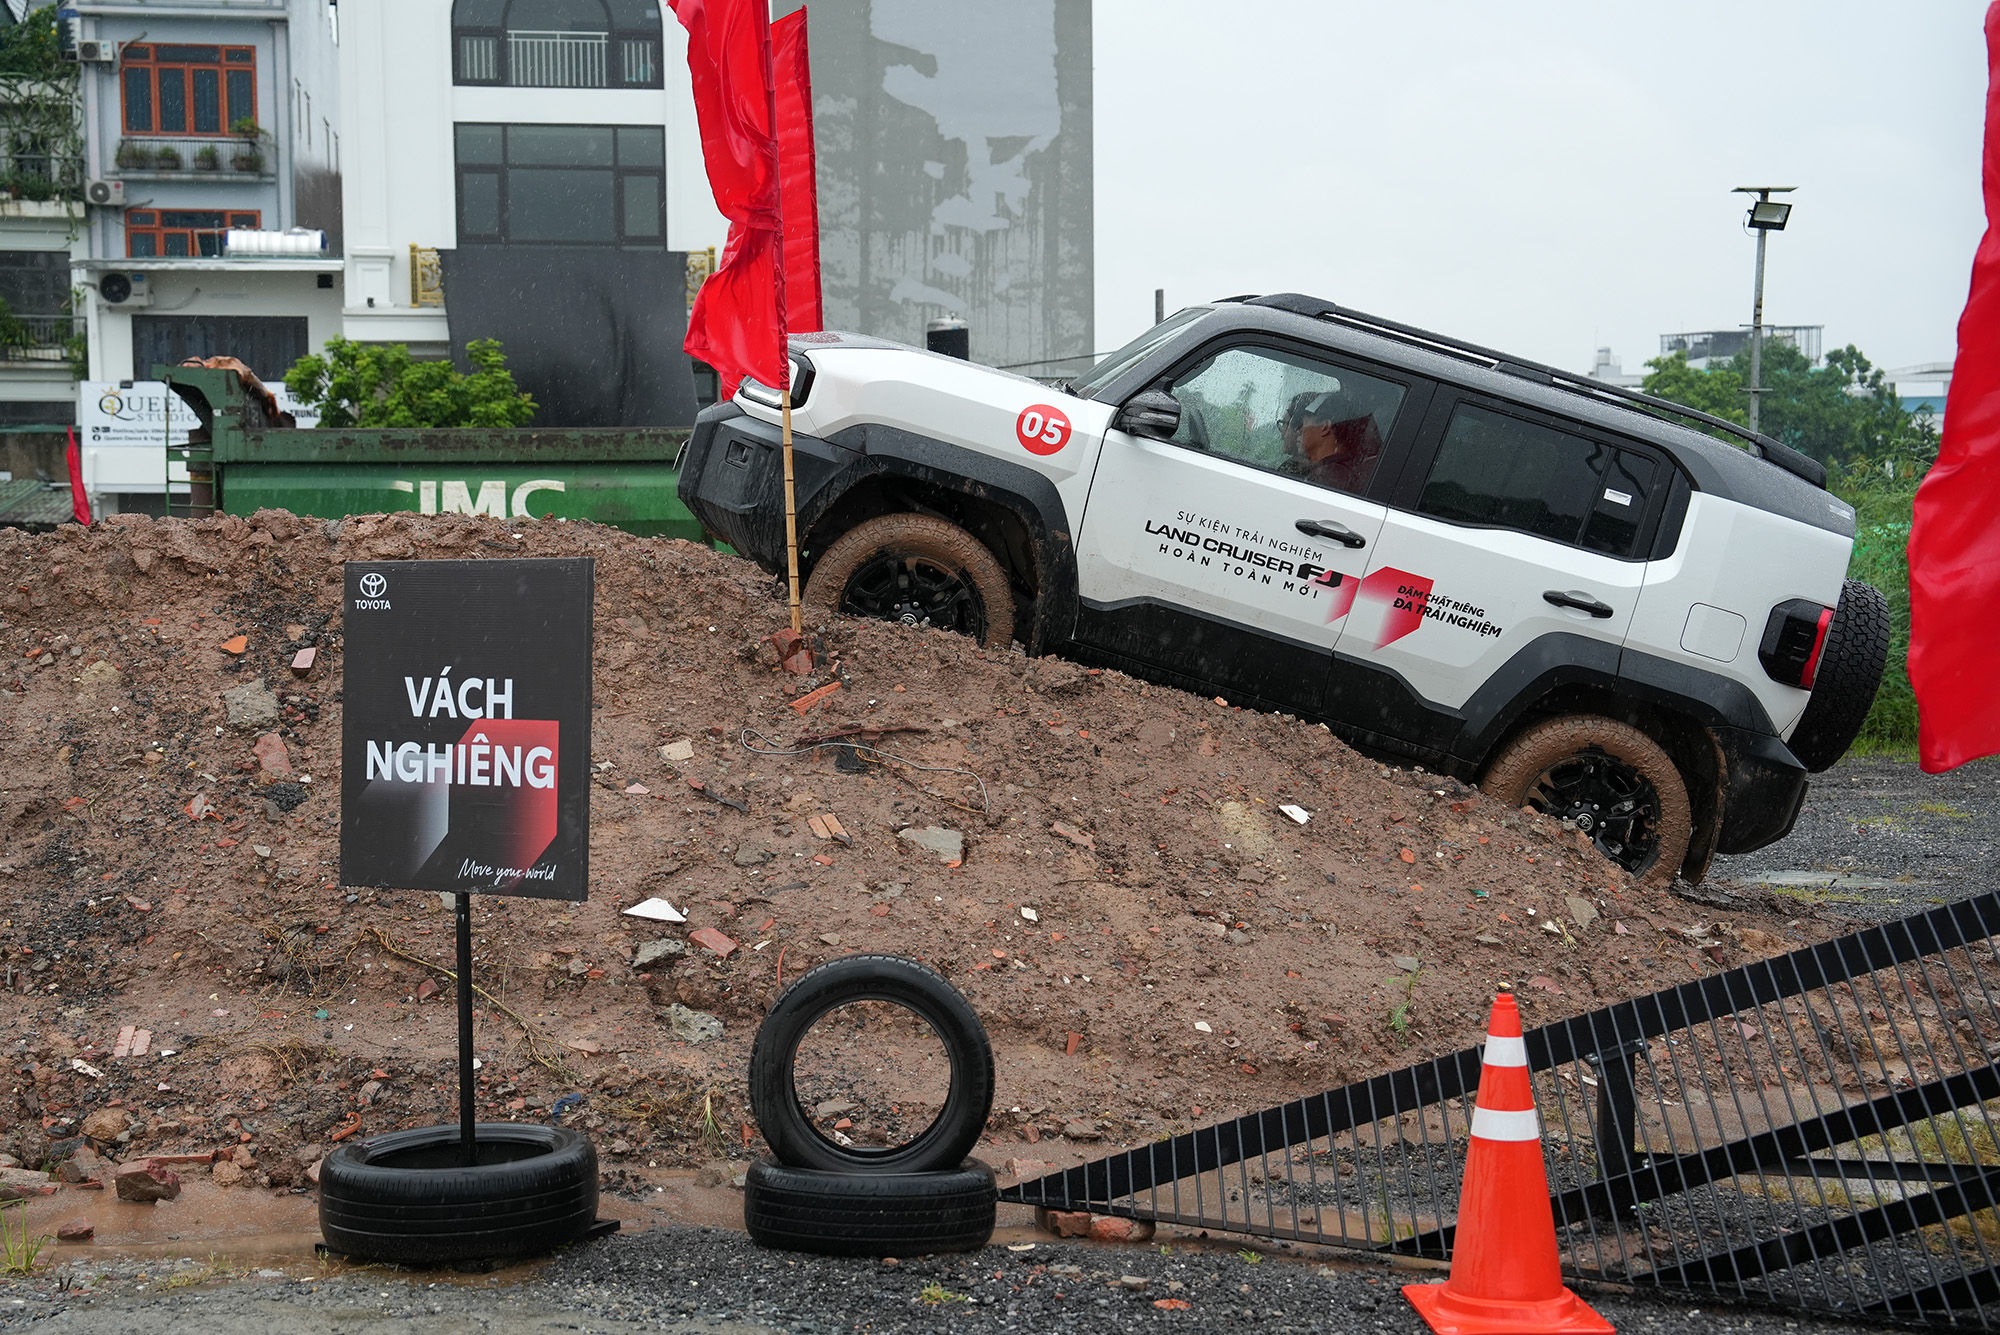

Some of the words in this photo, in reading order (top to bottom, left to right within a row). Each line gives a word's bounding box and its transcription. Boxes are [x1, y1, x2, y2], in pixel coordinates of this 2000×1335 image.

[1022, 411, 1065, 445] 05
[389, 479, 566, 521] IMC
[1145, 520, 1201, 547] LAND
[1203, 538, 1294, 575] CRUISER
[1296, 563, 1344, 588] FJ
[1177, 511, 1196, 525] SỰ
[1199, 517, 1230, 533] KIỆN
[1235, 527, 1264, 545] TRẢI
[1268, 538, 1323, 562] NGHIỆM
[1159, 543, 1211, 567] HOÀN
[1223, 562, 1272, 585] TOÀN
[1283, 581, 1318, 599] MỚI
[355, 600, 391, 610] TOYOTA
[1393, 597, 1413, 612] ĐA
[1416, 604, 1446, 622] TRẢI
[1446, 613, 1502, 638] NGHIỆM
[1397, 585, 1424, 599] ĐẬM
[1452, 601, 1485, 618] RIÊNG
[404, 666, 513, 719] VÁCH
[366, 733, 555, 789] NGHIÊNG
[458, 858, 493, 879] Move
[494, 867, 525, 885] your
[525, 864, 557, 881] world
